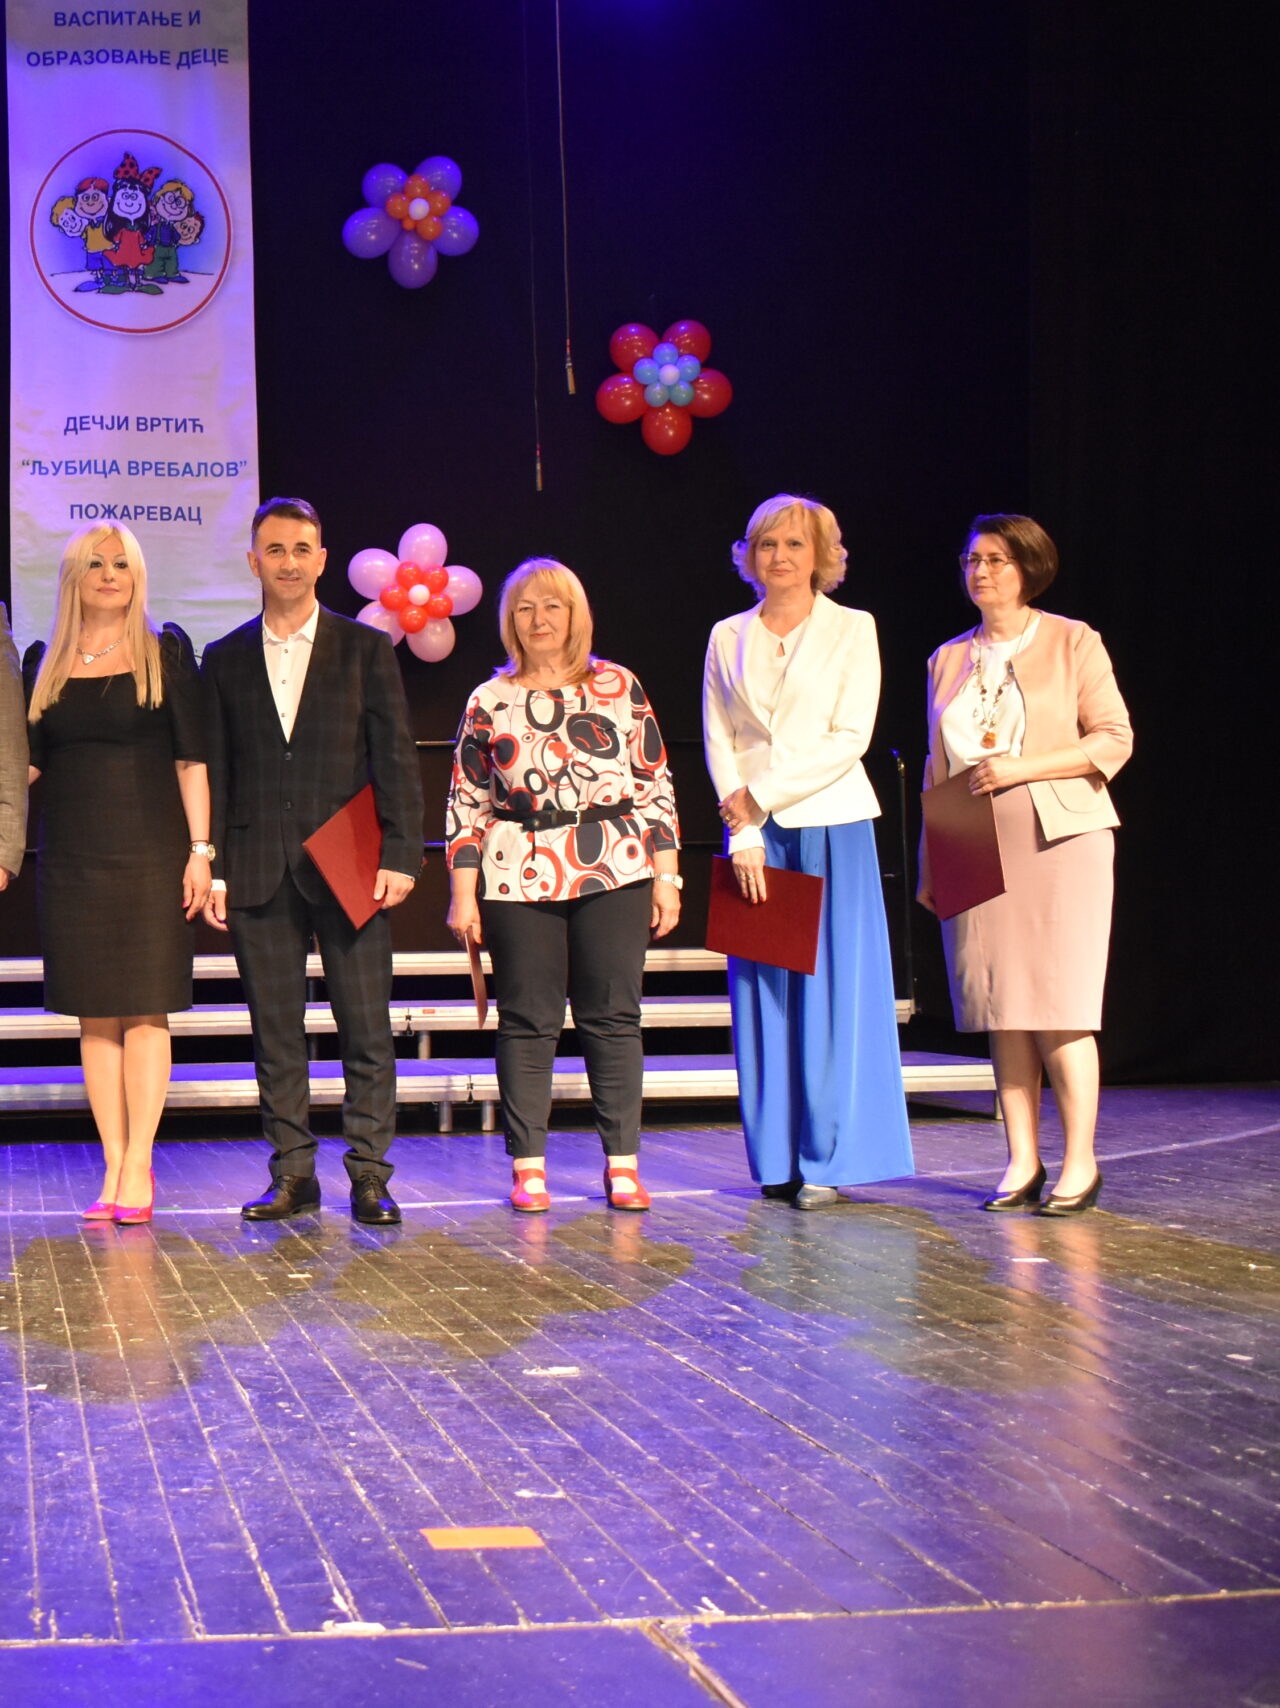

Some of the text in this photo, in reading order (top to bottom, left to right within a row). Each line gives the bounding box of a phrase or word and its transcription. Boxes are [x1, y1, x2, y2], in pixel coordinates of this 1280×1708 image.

[53, 10, 201, 28] ВАСПИТАЊЕ И
[26, 48, 229, 70] ОБРАЗОВАЊЕ ДЕЦЕ
[63, 416, 204, 436] ДЕЧЈИ ВРТИЋ
[21, 459, 248, 478] “ЉУБИЦА ВРЕБАЛОВ”
[69, 503, 202, 525] ПОЖАРЕВАЦ
